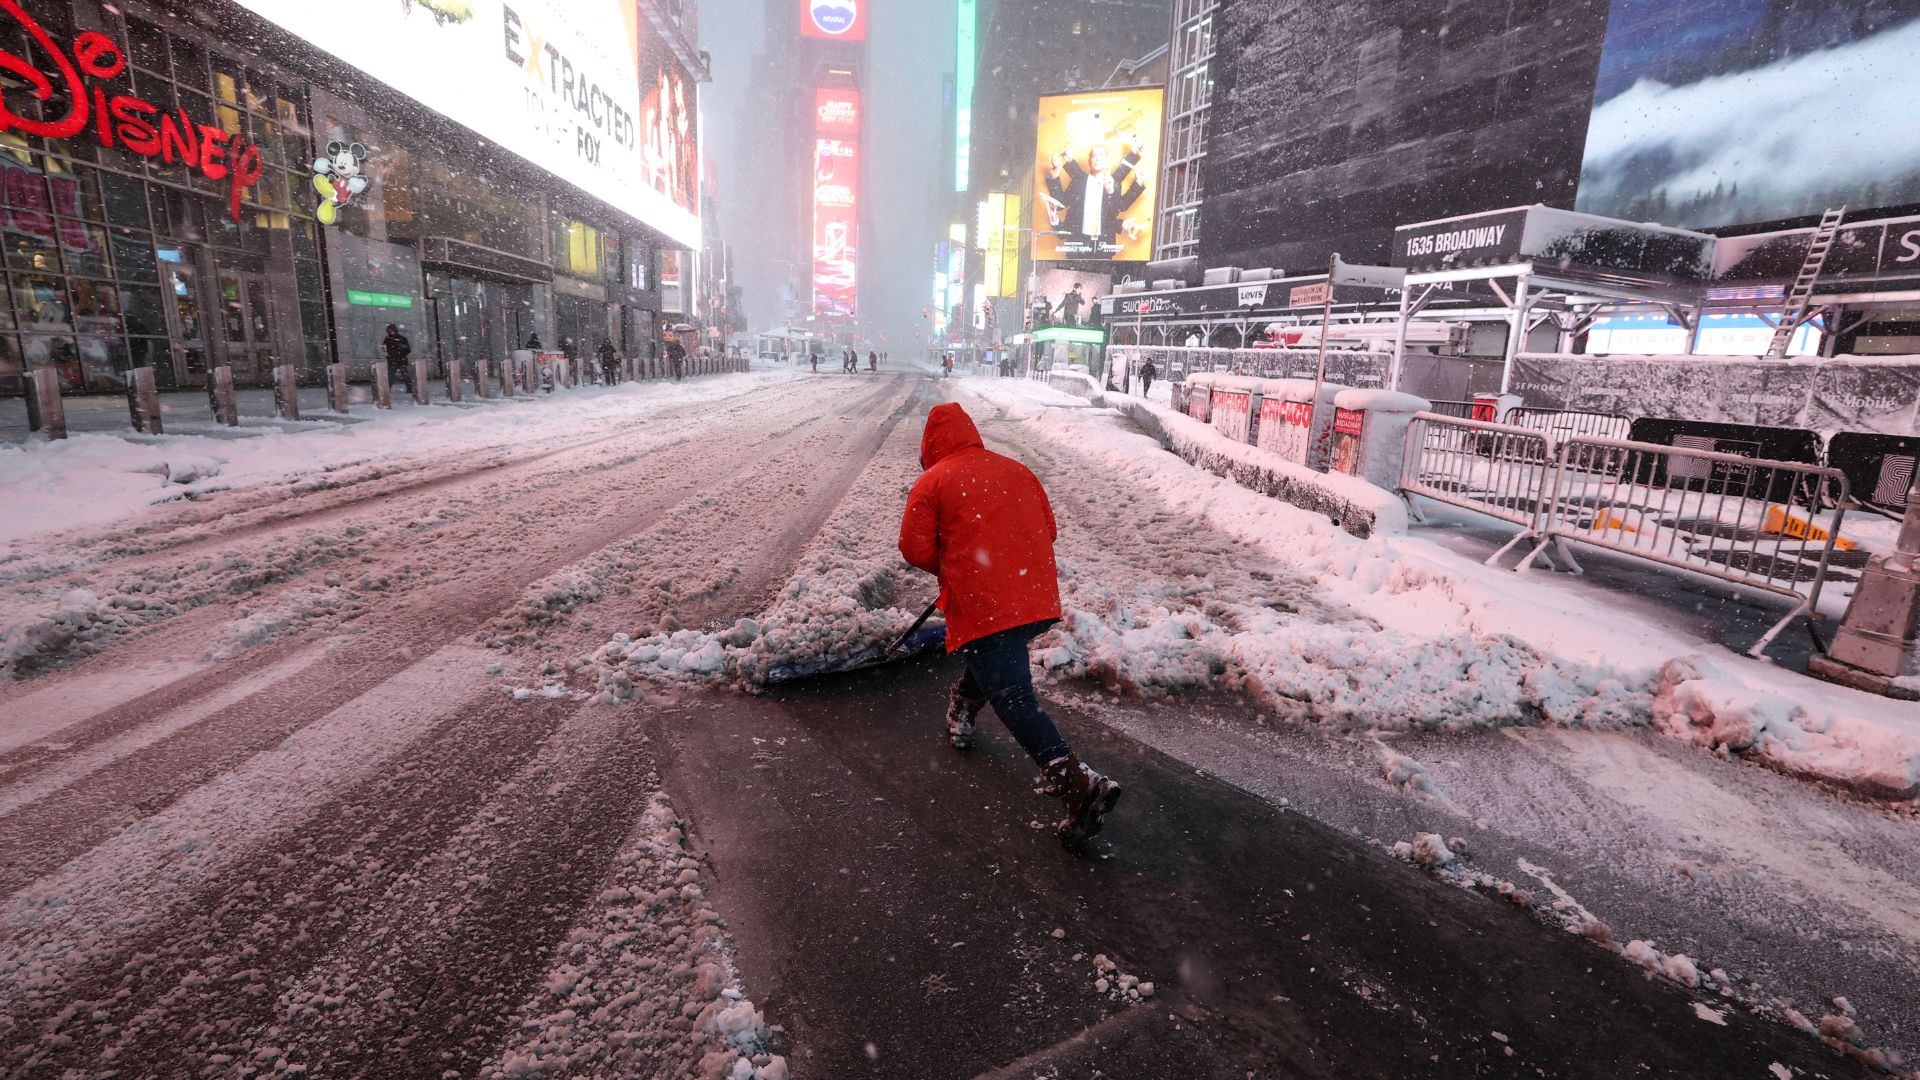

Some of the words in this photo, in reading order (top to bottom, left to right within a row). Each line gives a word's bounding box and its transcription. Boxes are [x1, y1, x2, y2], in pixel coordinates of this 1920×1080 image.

[503, 3, 635, 152] EXTRACTED
[577, 125, 603, 169] FOX
[1406, 234, 1434, 257] 1535
[1435, 224, 1507, 253] BROADWAY
[1212, 391, 1249, 414] CHICAGO
[1514, 382, 1563, 393] SEPHORA
[1261, 398, 1313, 428] CHICAGO
